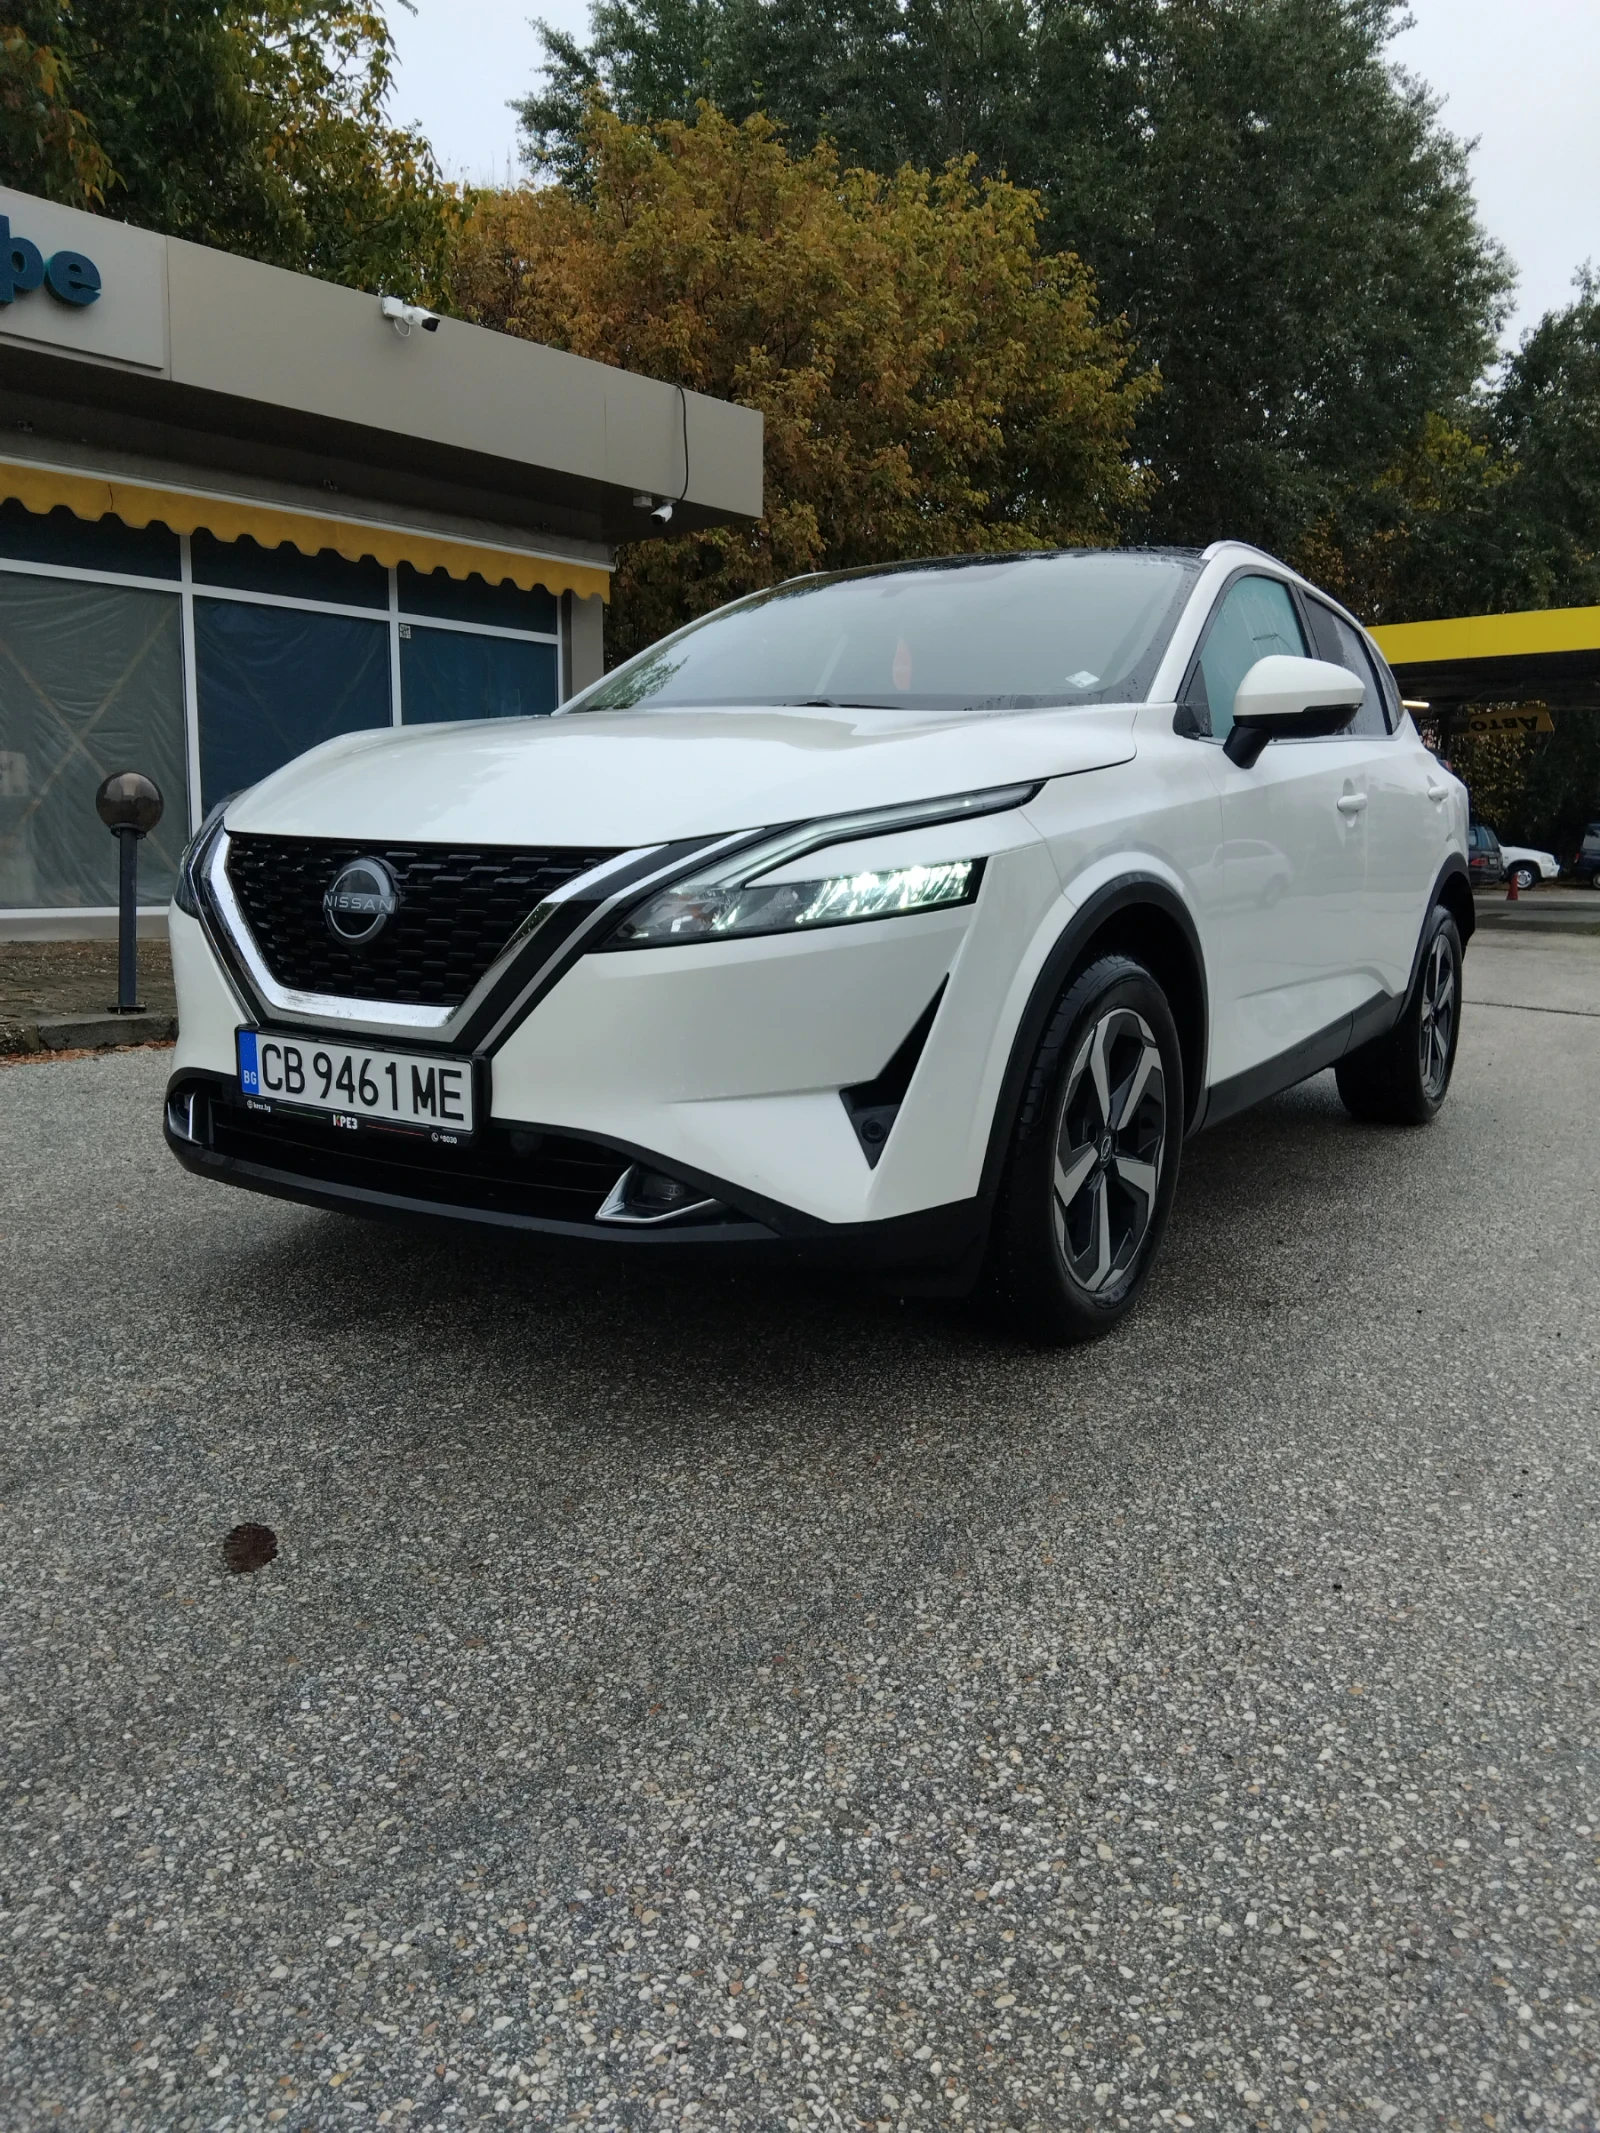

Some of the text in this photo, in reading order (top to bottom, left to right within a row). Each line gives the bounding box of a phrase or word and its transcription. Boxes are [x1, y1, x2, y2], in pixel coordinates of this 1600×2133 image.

[323, 894, 393, 912] NISSAN
[243, 1070, 257, 1085] BG
[261, 1043, 464, 1122] CB 9461 ME
